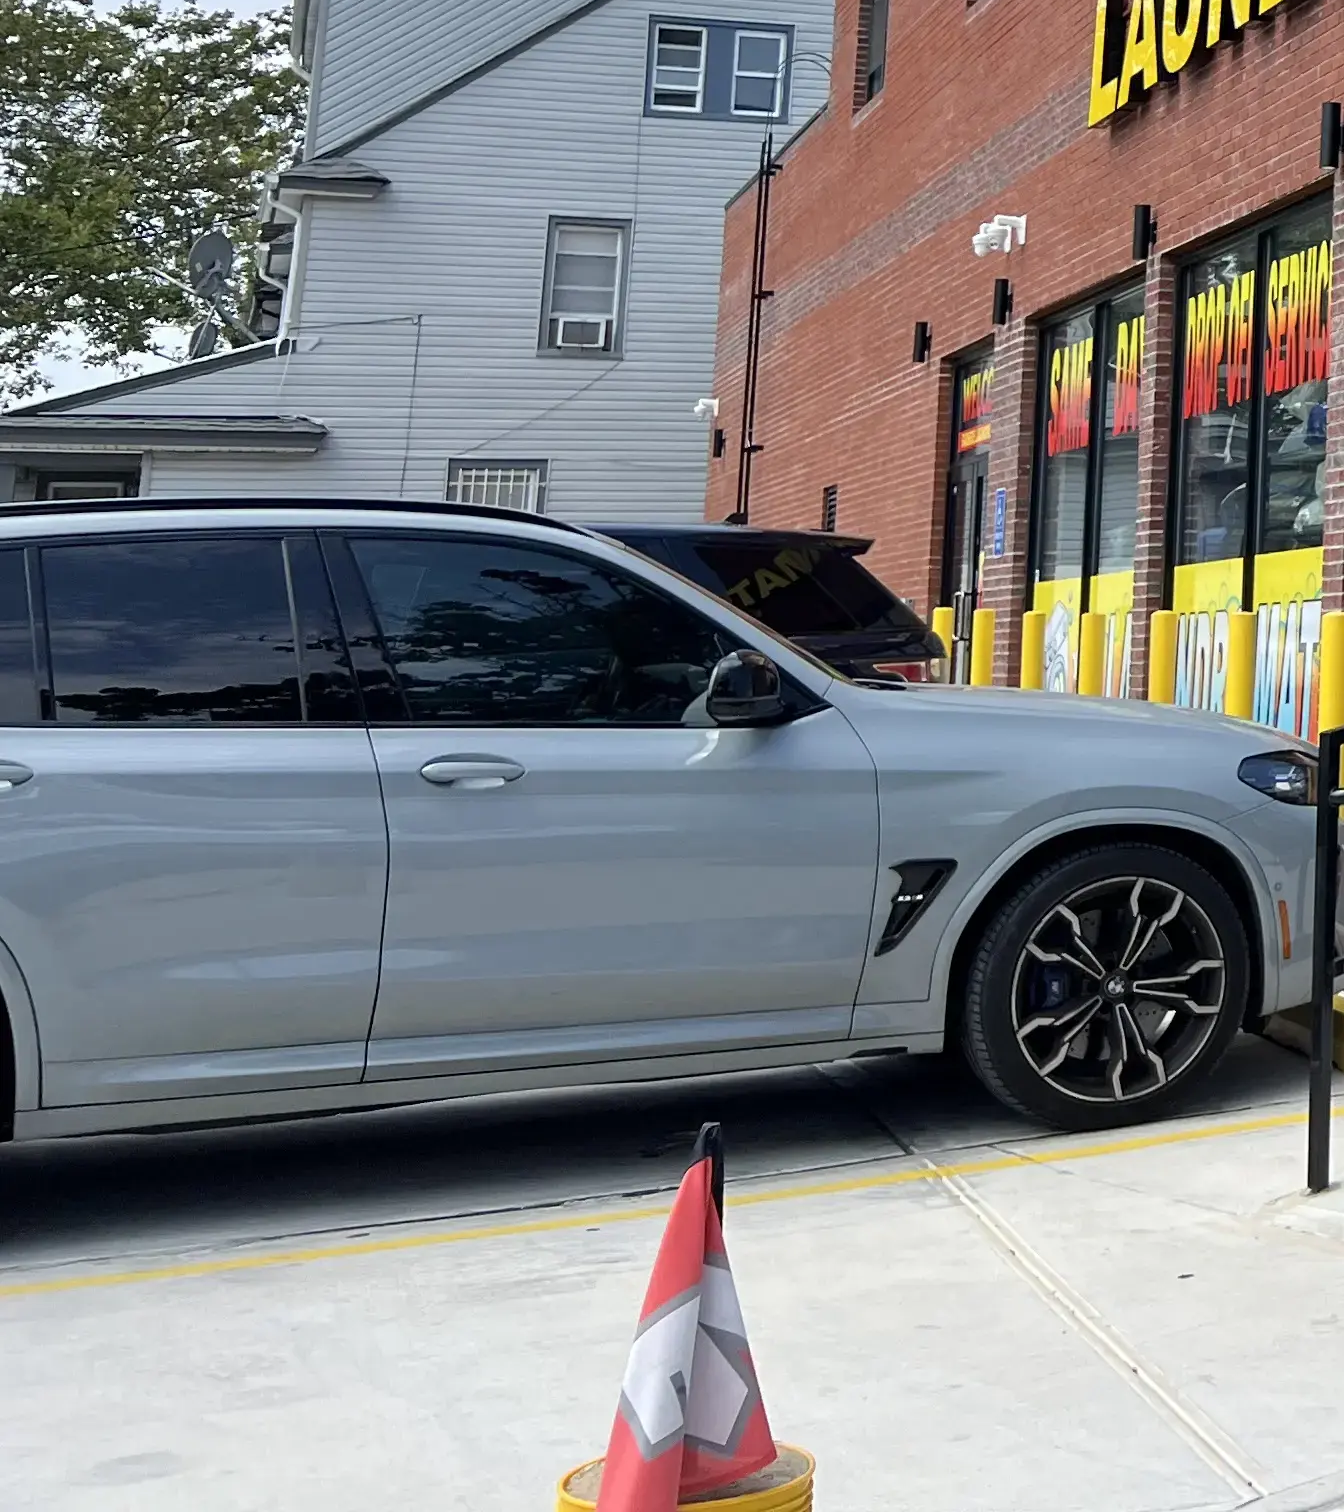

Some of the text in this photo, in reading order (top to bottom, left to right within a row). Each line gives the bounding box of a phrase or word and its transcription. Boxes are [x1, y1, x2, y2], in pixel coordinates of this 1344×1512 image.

[1048, 336, 1094, 457] SAME
[1184, 283, 1226, 420] DROP
[1265, 239, 1333, 397] SERVIC
